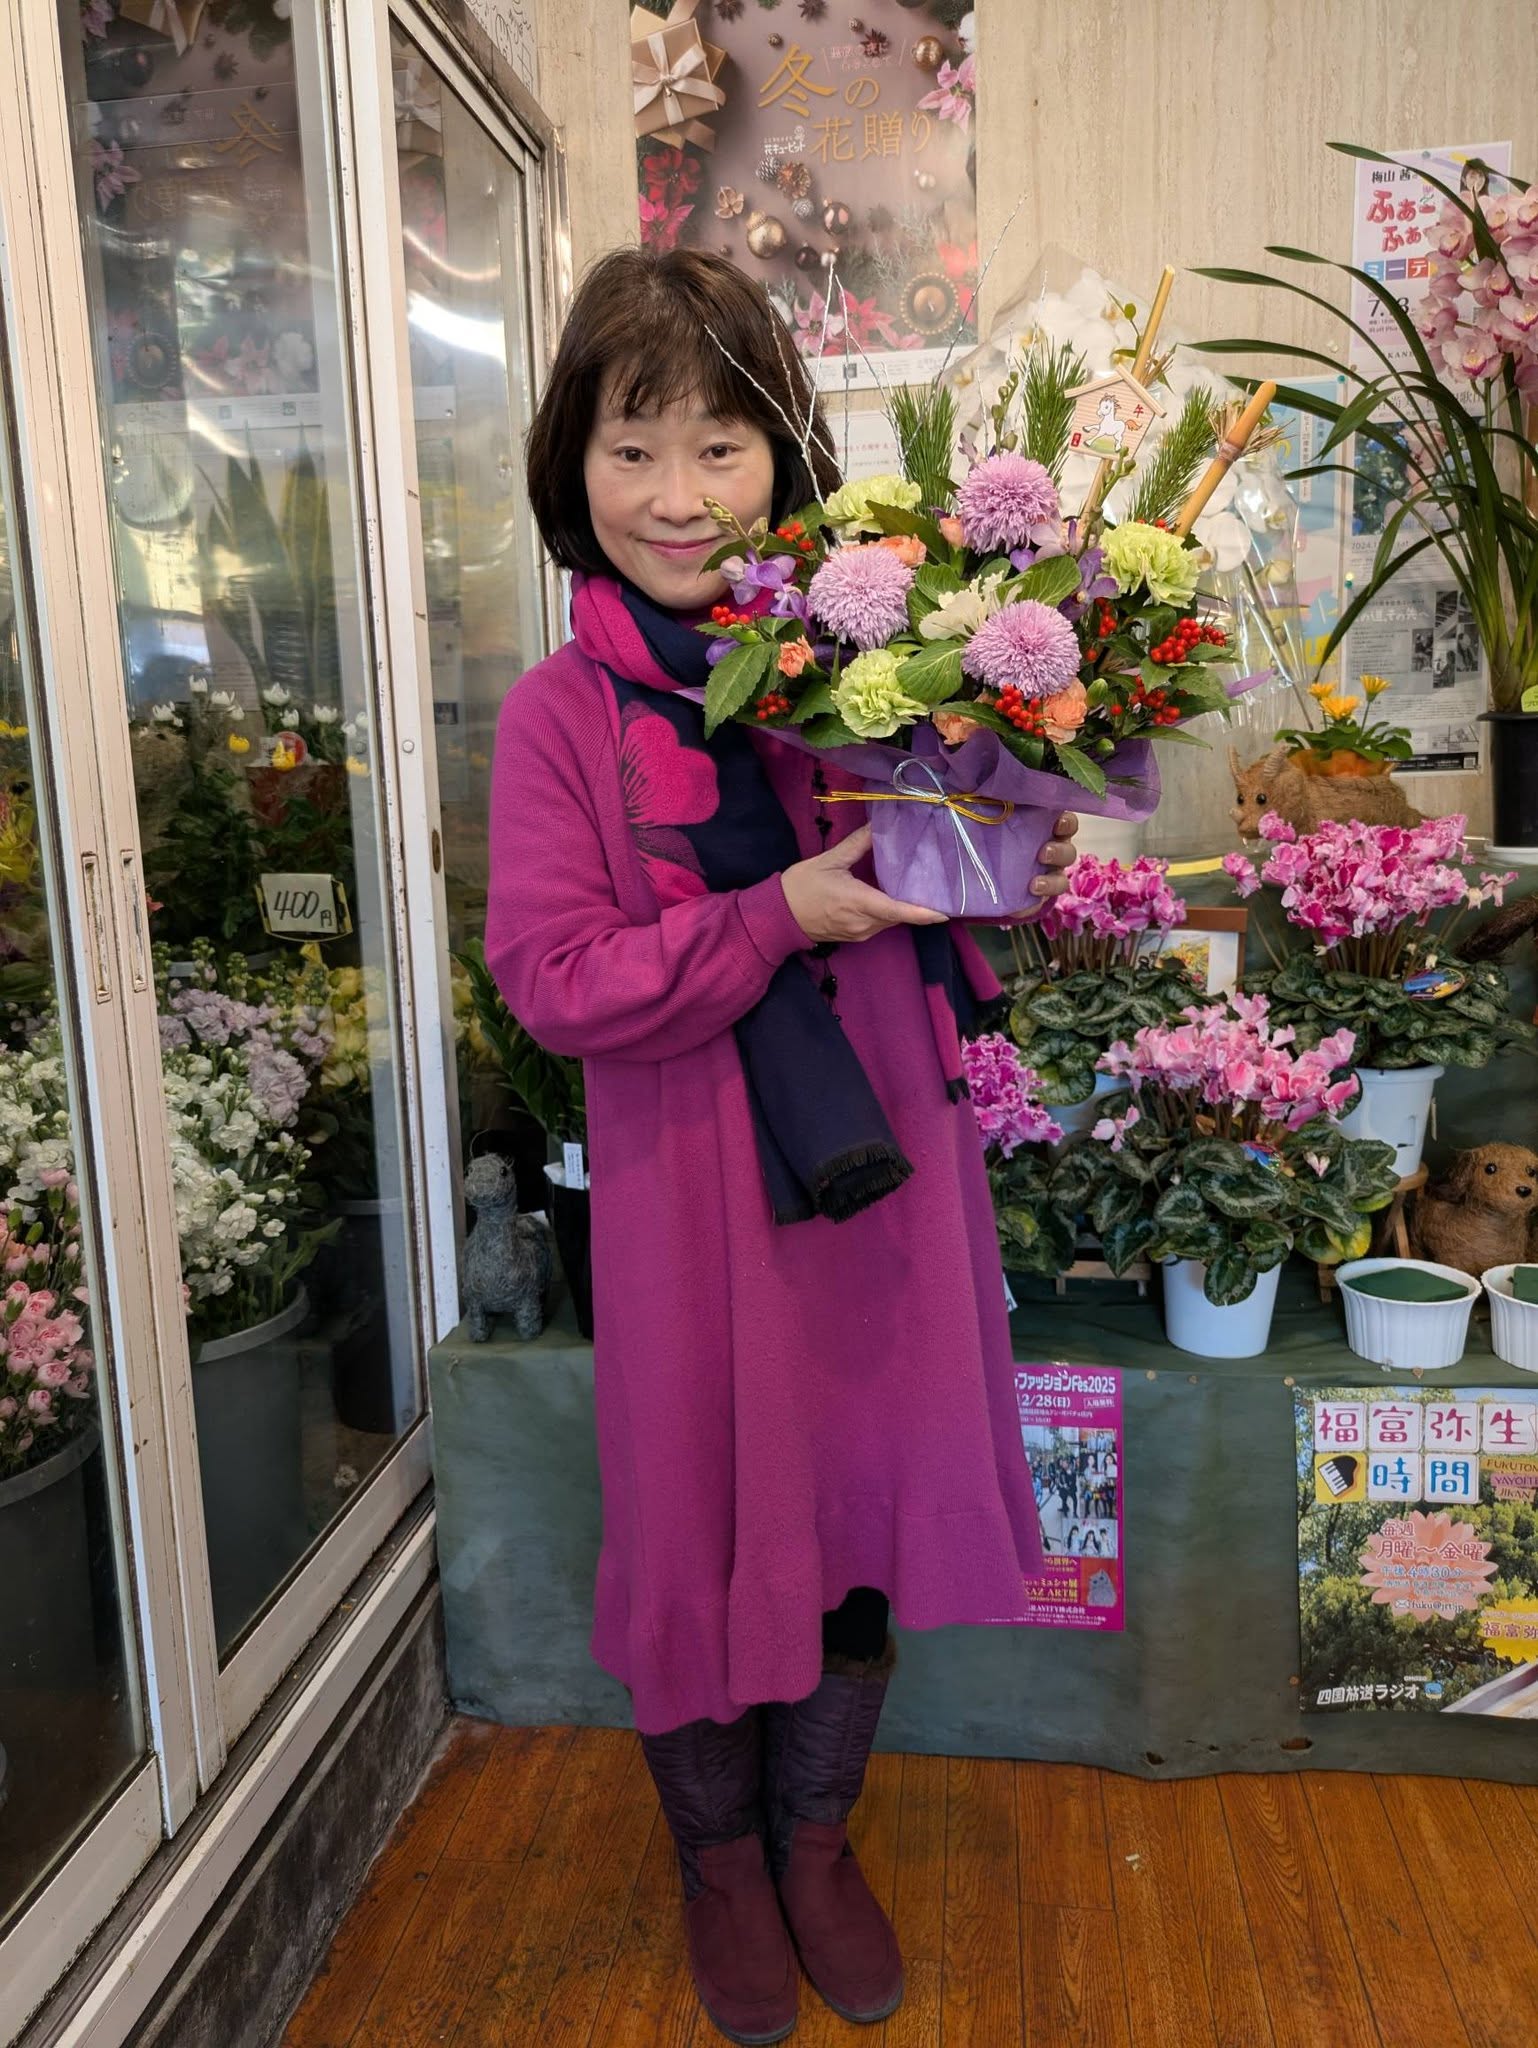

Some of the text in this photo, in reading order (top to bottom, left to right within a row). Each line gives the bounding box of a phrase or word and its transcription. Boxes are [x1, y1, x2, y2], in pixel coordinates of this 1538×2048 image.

[758, 44, 881, 118] 冬の
[811, 112, 932, 164] 花贈り
[274, 890, 332, 928] 400円
[1015, 1371, 1116, 1394] ファッションFes2025
[1318, 1405, 1527, 1445] 福富弥生
[1372, 1456, 1470, 1495] 時間
[1500, 1488, 1531, 1499] JIKAN
[1383, 1522, 1415, 1536] 毎週
[1317, 1683, 1419, 1705] 四国放送ラジオ
